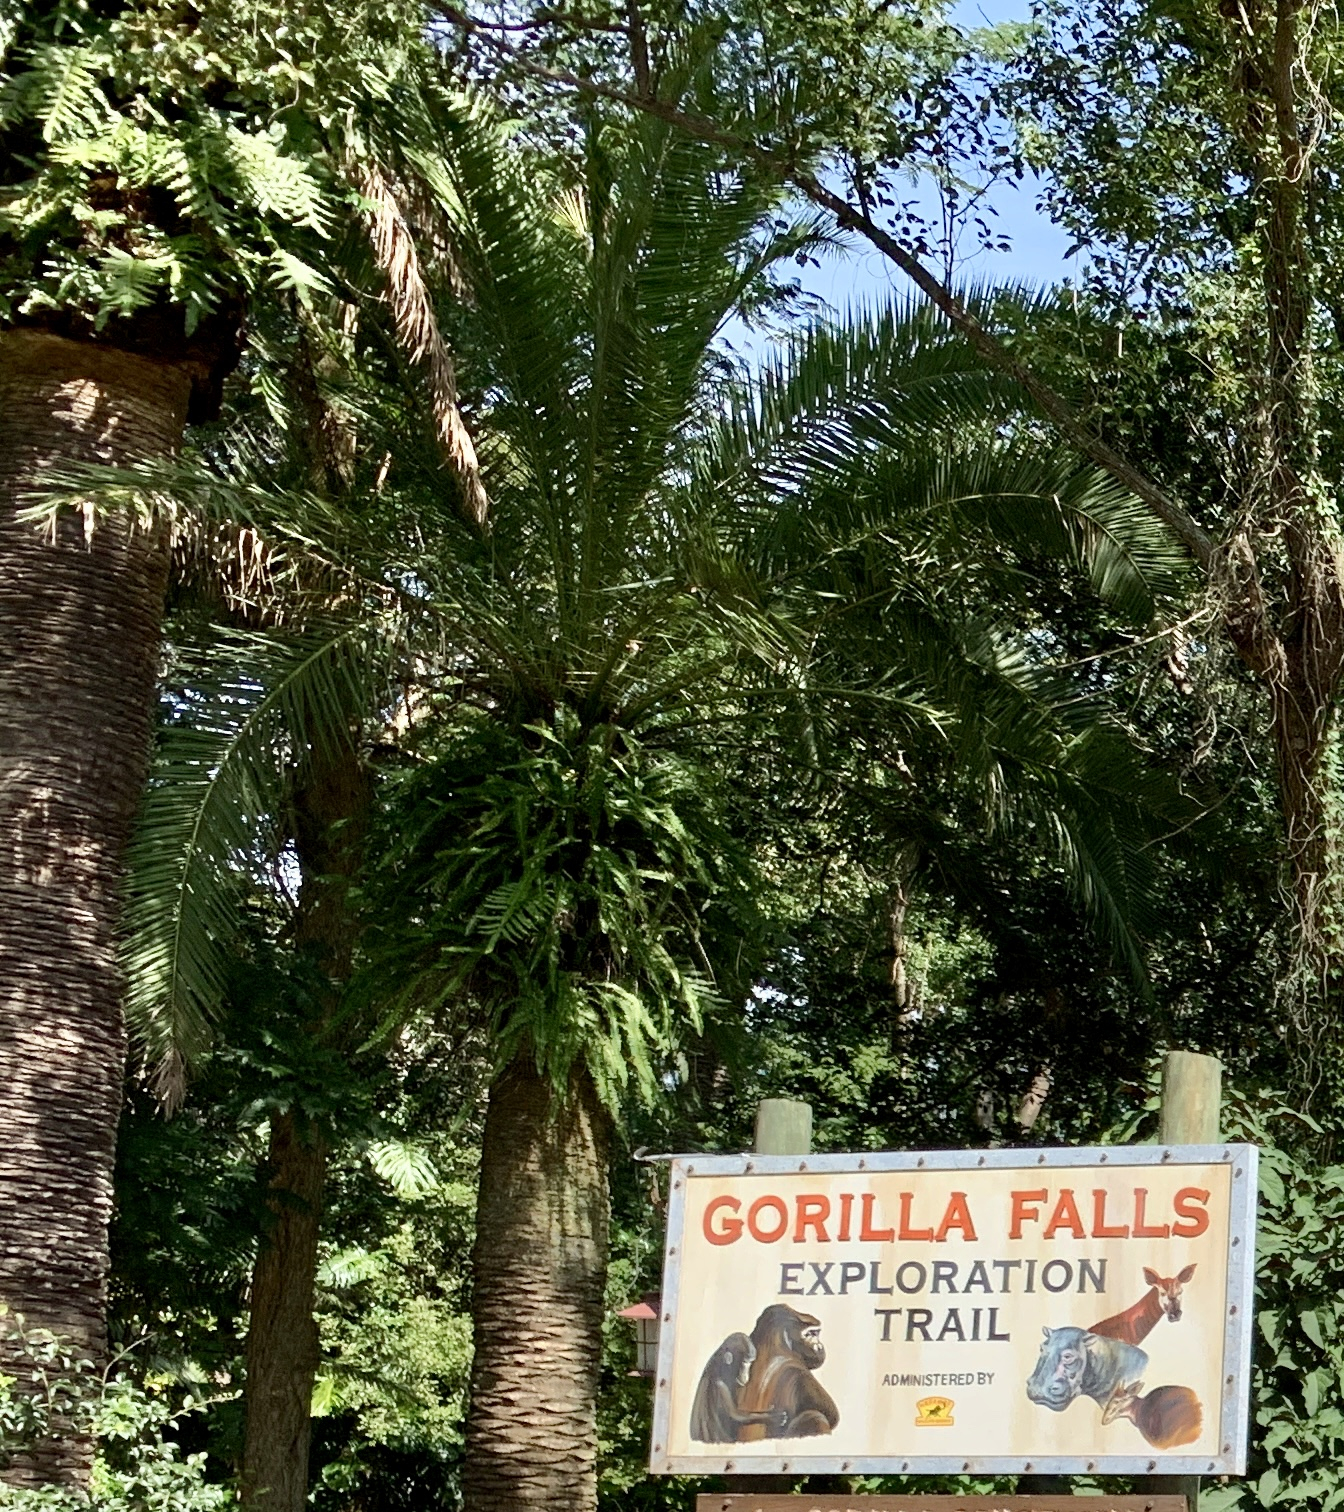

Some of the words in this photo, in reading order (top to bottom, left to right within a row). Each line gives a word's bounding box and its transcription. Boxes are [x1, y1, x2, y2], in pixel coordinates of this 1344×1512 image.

[702, 1191, 978, 1246] GORILLA
[1008, 1187, 1211, 1240] FALLS
[777, 1258, 1108, 1296] EXPLORATION
[873, 1306, 1011, 1342] TRAIL
[882, 1373, 974, 1387] ADMINISTERED
[977, 1371, 995, 1386] BY
